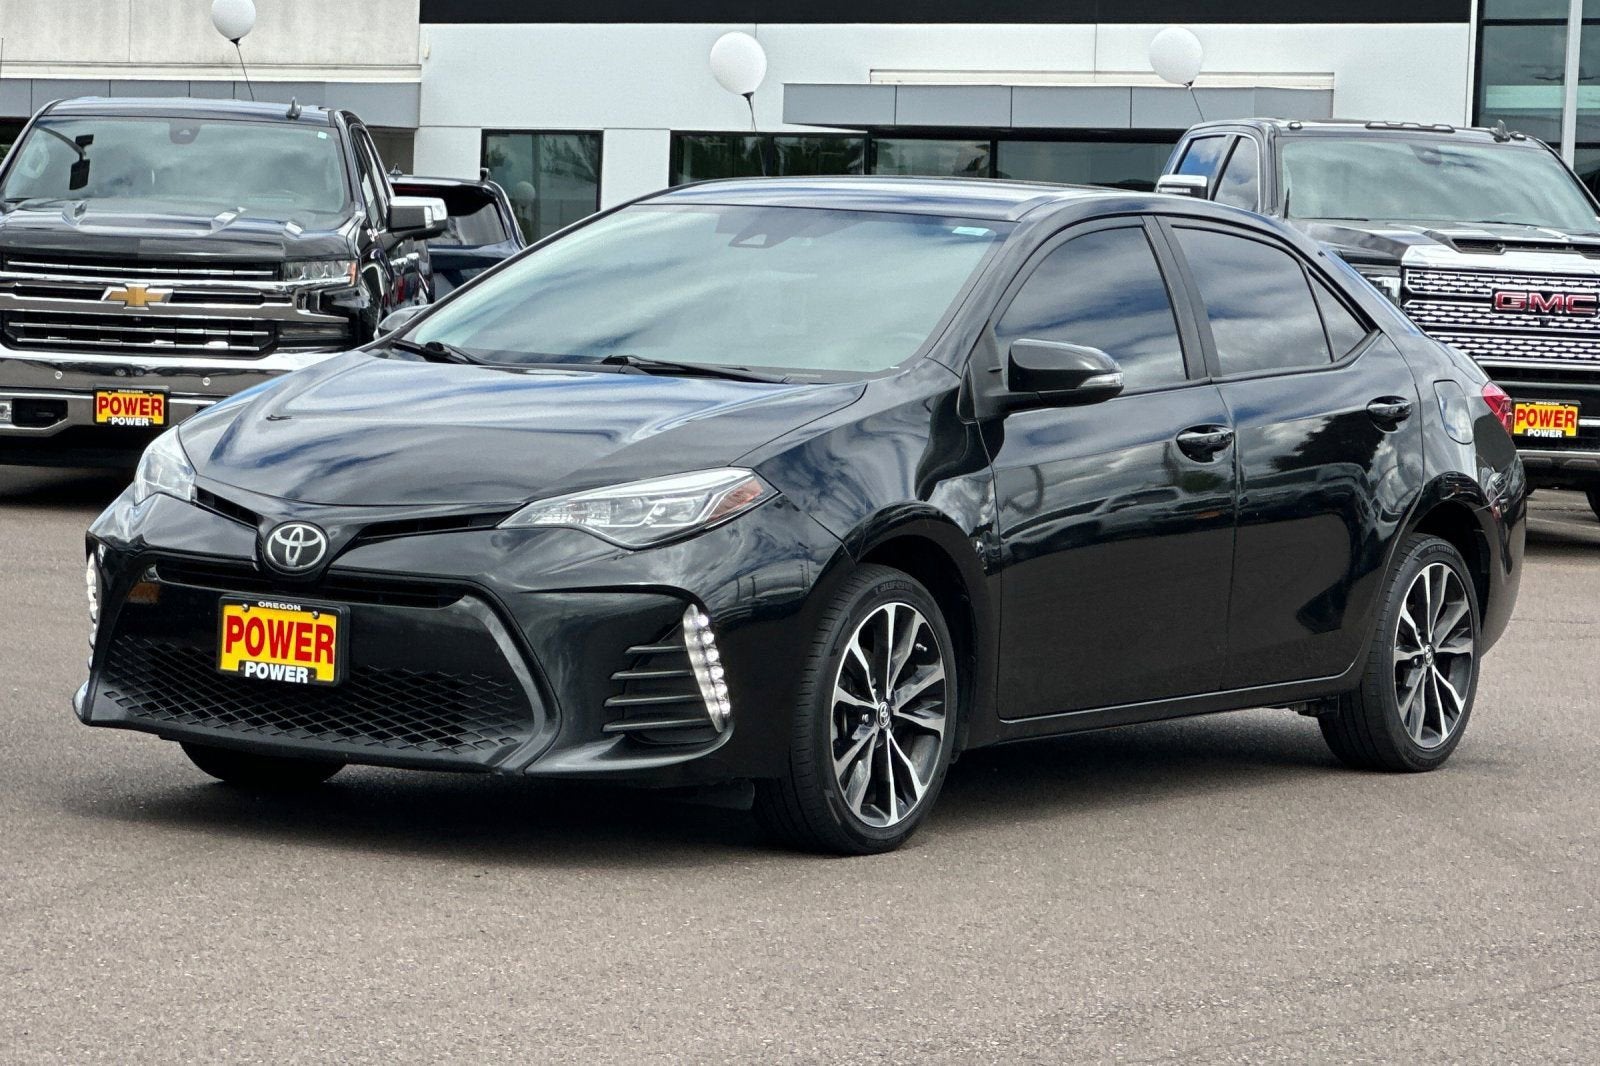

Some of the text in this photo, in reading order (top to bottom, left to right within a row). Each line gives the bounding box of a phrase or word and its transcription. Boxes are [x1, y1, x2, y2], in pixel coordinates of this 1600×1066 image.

[1495, 291, 1597, 315] GMC
[98, 396, 163, 416] POWER
[111, 417, 149, 426] POWER
[1516, 408, 1576, 428] POWER
[1527, 429, 1563, 438] POWER
[258, 601, 301, 611] OREGON
[225, 615, 335, 665] POWER
[244, 661, 308, 684] POWER
